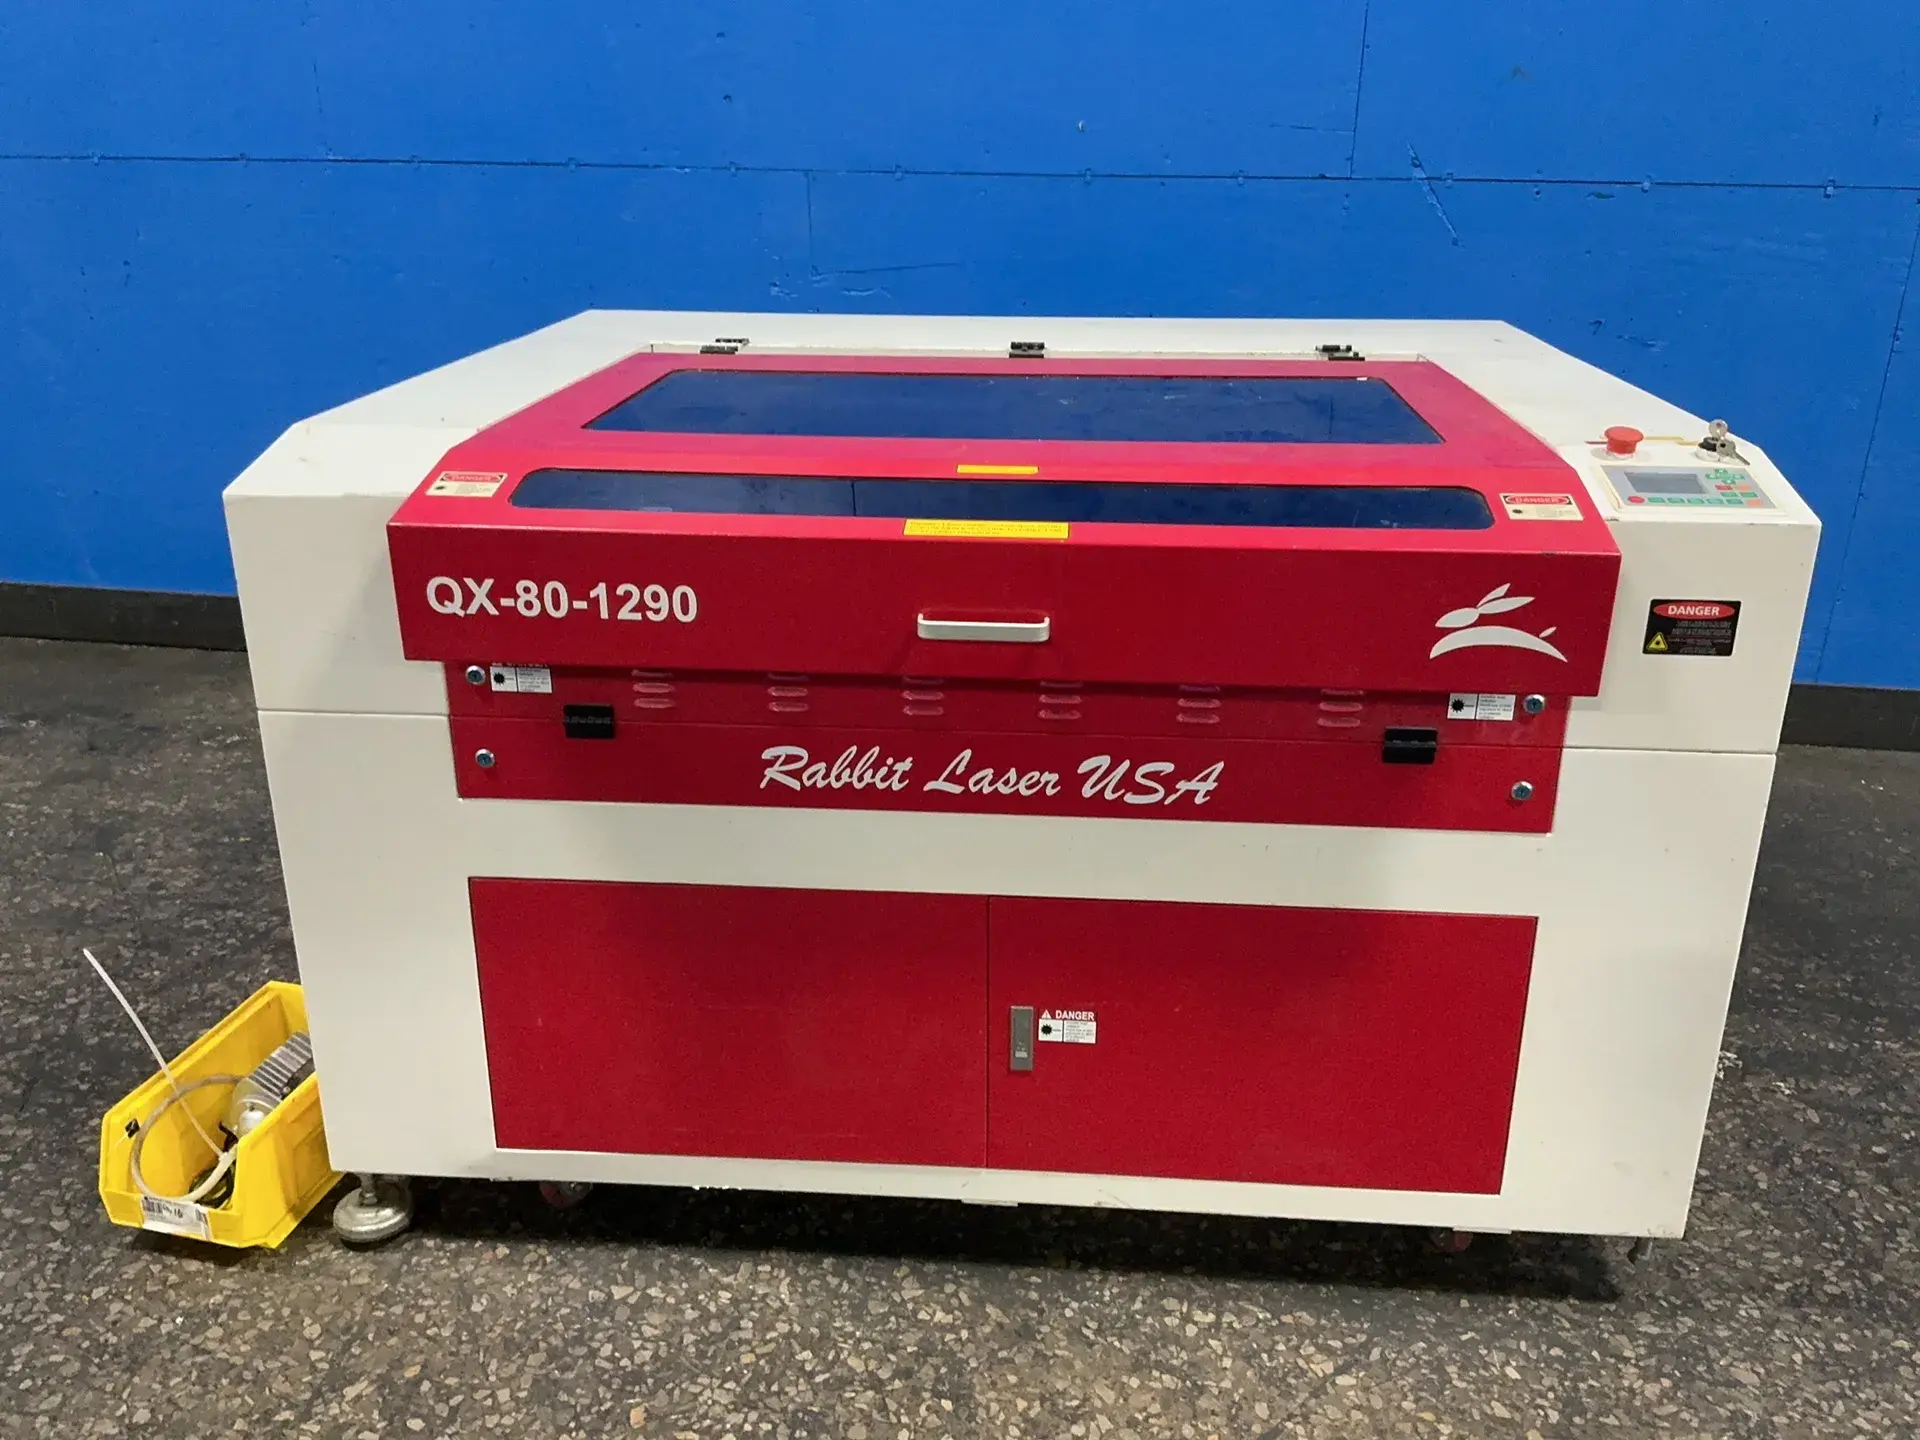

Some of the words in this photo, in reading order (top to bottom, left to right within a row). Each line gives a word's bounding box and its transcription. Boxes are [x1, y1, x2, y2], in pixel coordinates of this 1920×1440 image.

[426, 576, 698, 623] QX-80-1290
[1667, 605, 1720, 616] DANGER
[759, 745, 913, 791] Rabbit
[923, 748, 1061, 796] Laser
[1077, 755, 1225, 805] USA
[1055, 1010, 1095, 1020] DANGER
